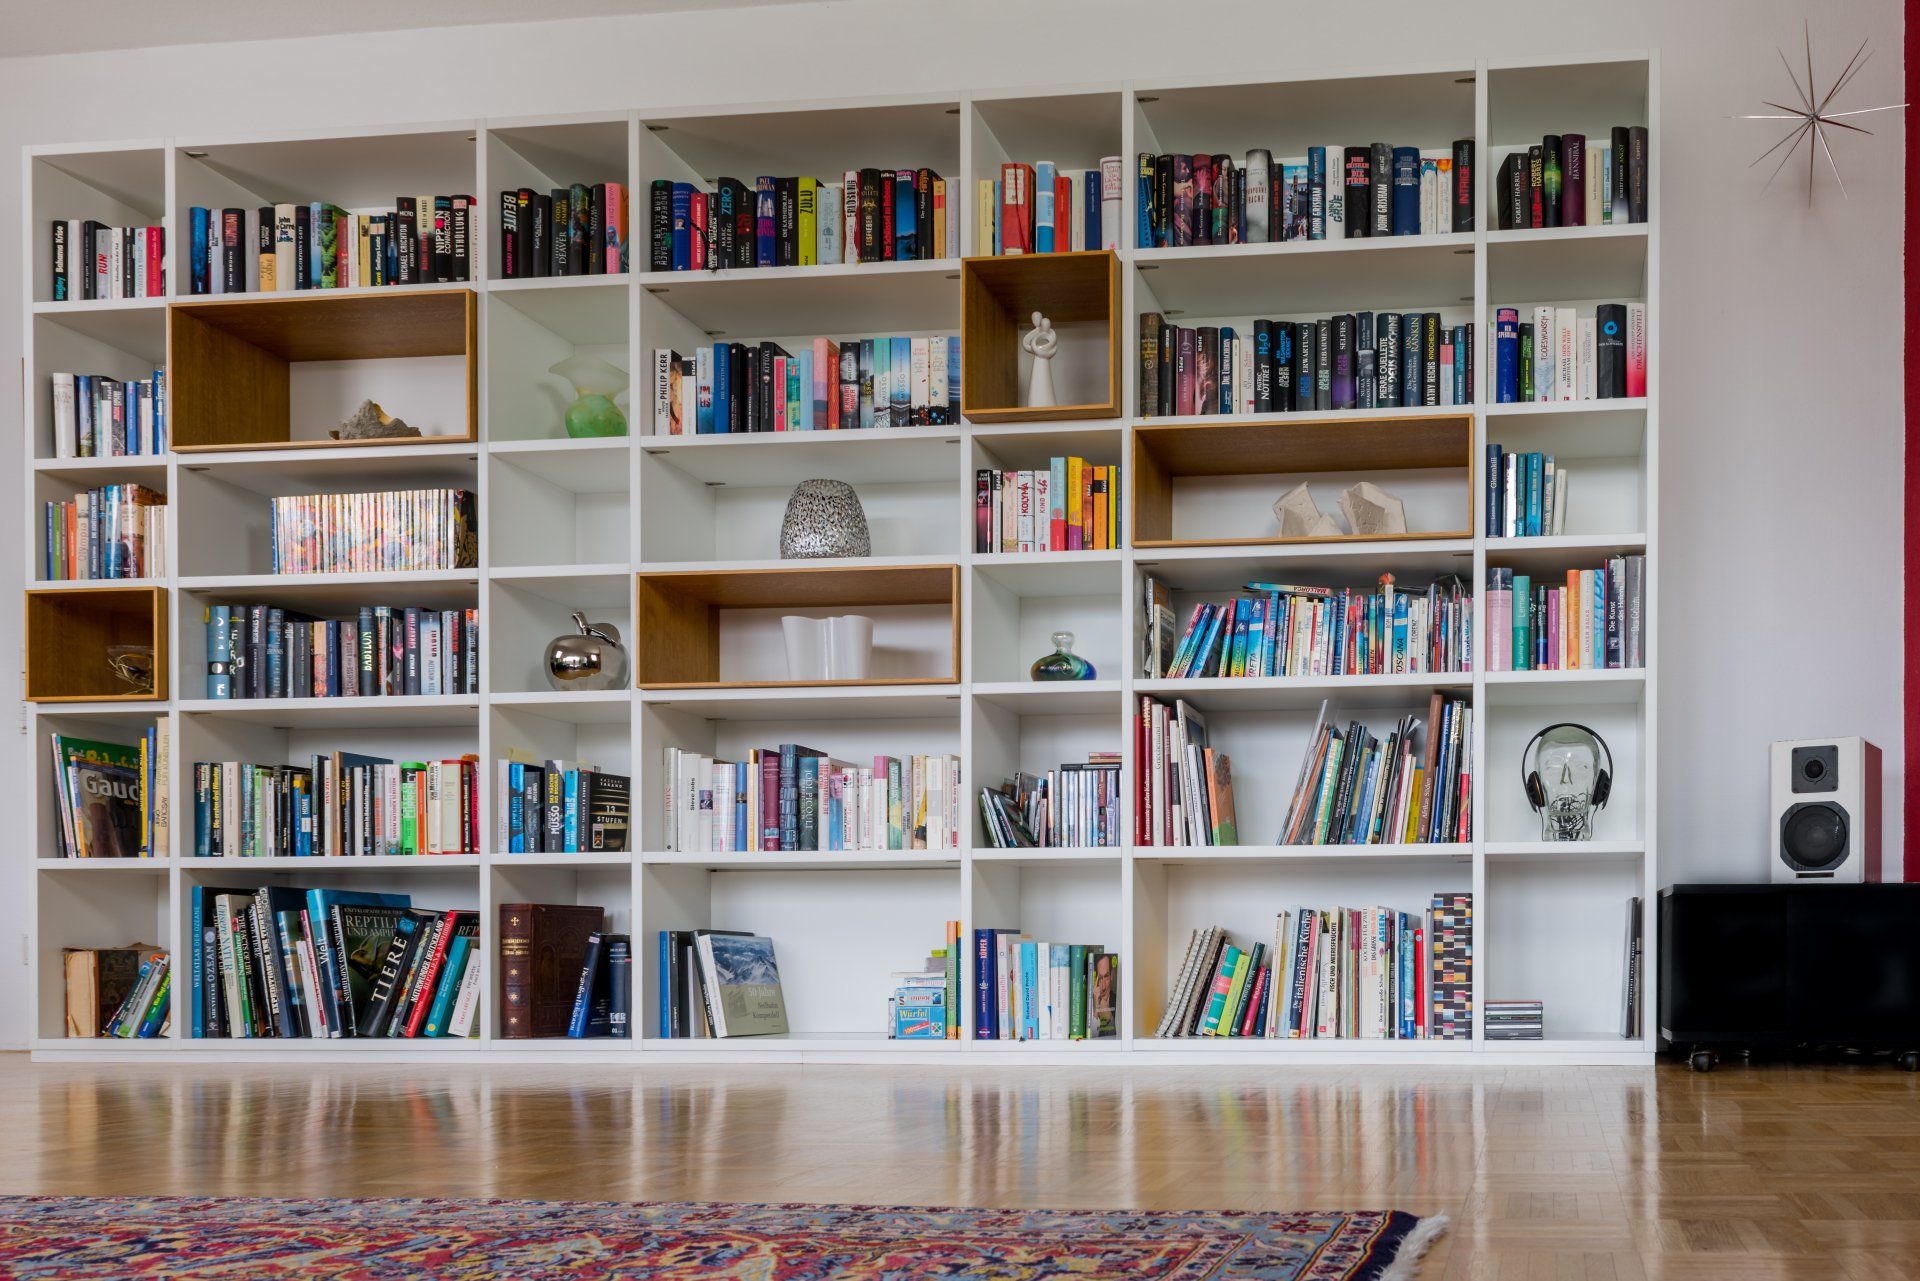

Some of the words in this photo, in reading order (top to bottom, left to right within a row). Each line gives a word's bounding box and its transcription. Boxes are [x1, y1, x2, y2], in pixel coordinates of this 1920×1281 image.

[1572, 140, 1580, 180] HANNIBAL
[504, 195, 517, 231] BEUTE
[721, 187, 732, 216] ZERO
[800, 190, 813, 214] ZULU
[1312, 187, 1322, 217] GRISHAM
[1333, 195, 1343, 223] GRUE
[1378, 184, 1388, 213] GRISHAM
[1514, 198, 1522, 224] ROBERT
[55, 226, 64, 243] Krise
[454, 211, 465, 257] ENTHÜLLUNG
[865, 215, 873, 246] EISFIEBER
[1312, 219, 1322, 234] JOHN
[1378, 214, 1389, 231] JOHN
[55, 245, 64, 272] Bahama
[559, 231, 567, 264] DEAVER
[400, 255, 408, 280] MICHAEL
[1388, 314, 1398, 358] MASCHINE
[1411, 317, 1419, 352] RANKIN
[1540, 315, 1549, 360] TODESWUNSCH
[660, 354, 668, 374] KERR
[1379, 337, 1388, 374] OUELLETTE
[1261, 363, 1270, 400] NOTTRET
[1427, 361, 1436, 383] REICHS
[660, 375, 668, 400] PHILIP
[1379, 375, 1388, 399] PIERRE
[1427, 384, 1436, 406] KATHY
[1021, 483, 1029, 514] KOLYMA
[1518, 591, 1526, 618] Lernen
[362, 631, 372, 672] BABYLON
[1143, 700, 1151, 729] JAPAN
[1154, 725, 1162, 770] Griechenland
[86, 774, 139, 801] Gaud
[805, 769, 813, 789] JODI
[550, 806, 560, 835] MUSSO
[597, 816, 623, 824] STUFEN
[606, 806, 616, 814] 13
[805, 792, 813, 830] PICOULT
[1421, 798, 1430, 819] Afrikas
[1300, 912, 1312, 943] Küche
[317, 937, 329, 965] Welt
[978, 938, 987, 959] KÖRPER
[206, 946, 215, 983] OZEAN
[371, 936, 407, 1002] TIERE
[1294, 946, 1308, 999] italienische
[264, 954, 280, 1015] EXPEDITIONEN
[411, 960, 430, 1002] NATURWUNDER
[899, 1008, 929, 1018] Würfel
